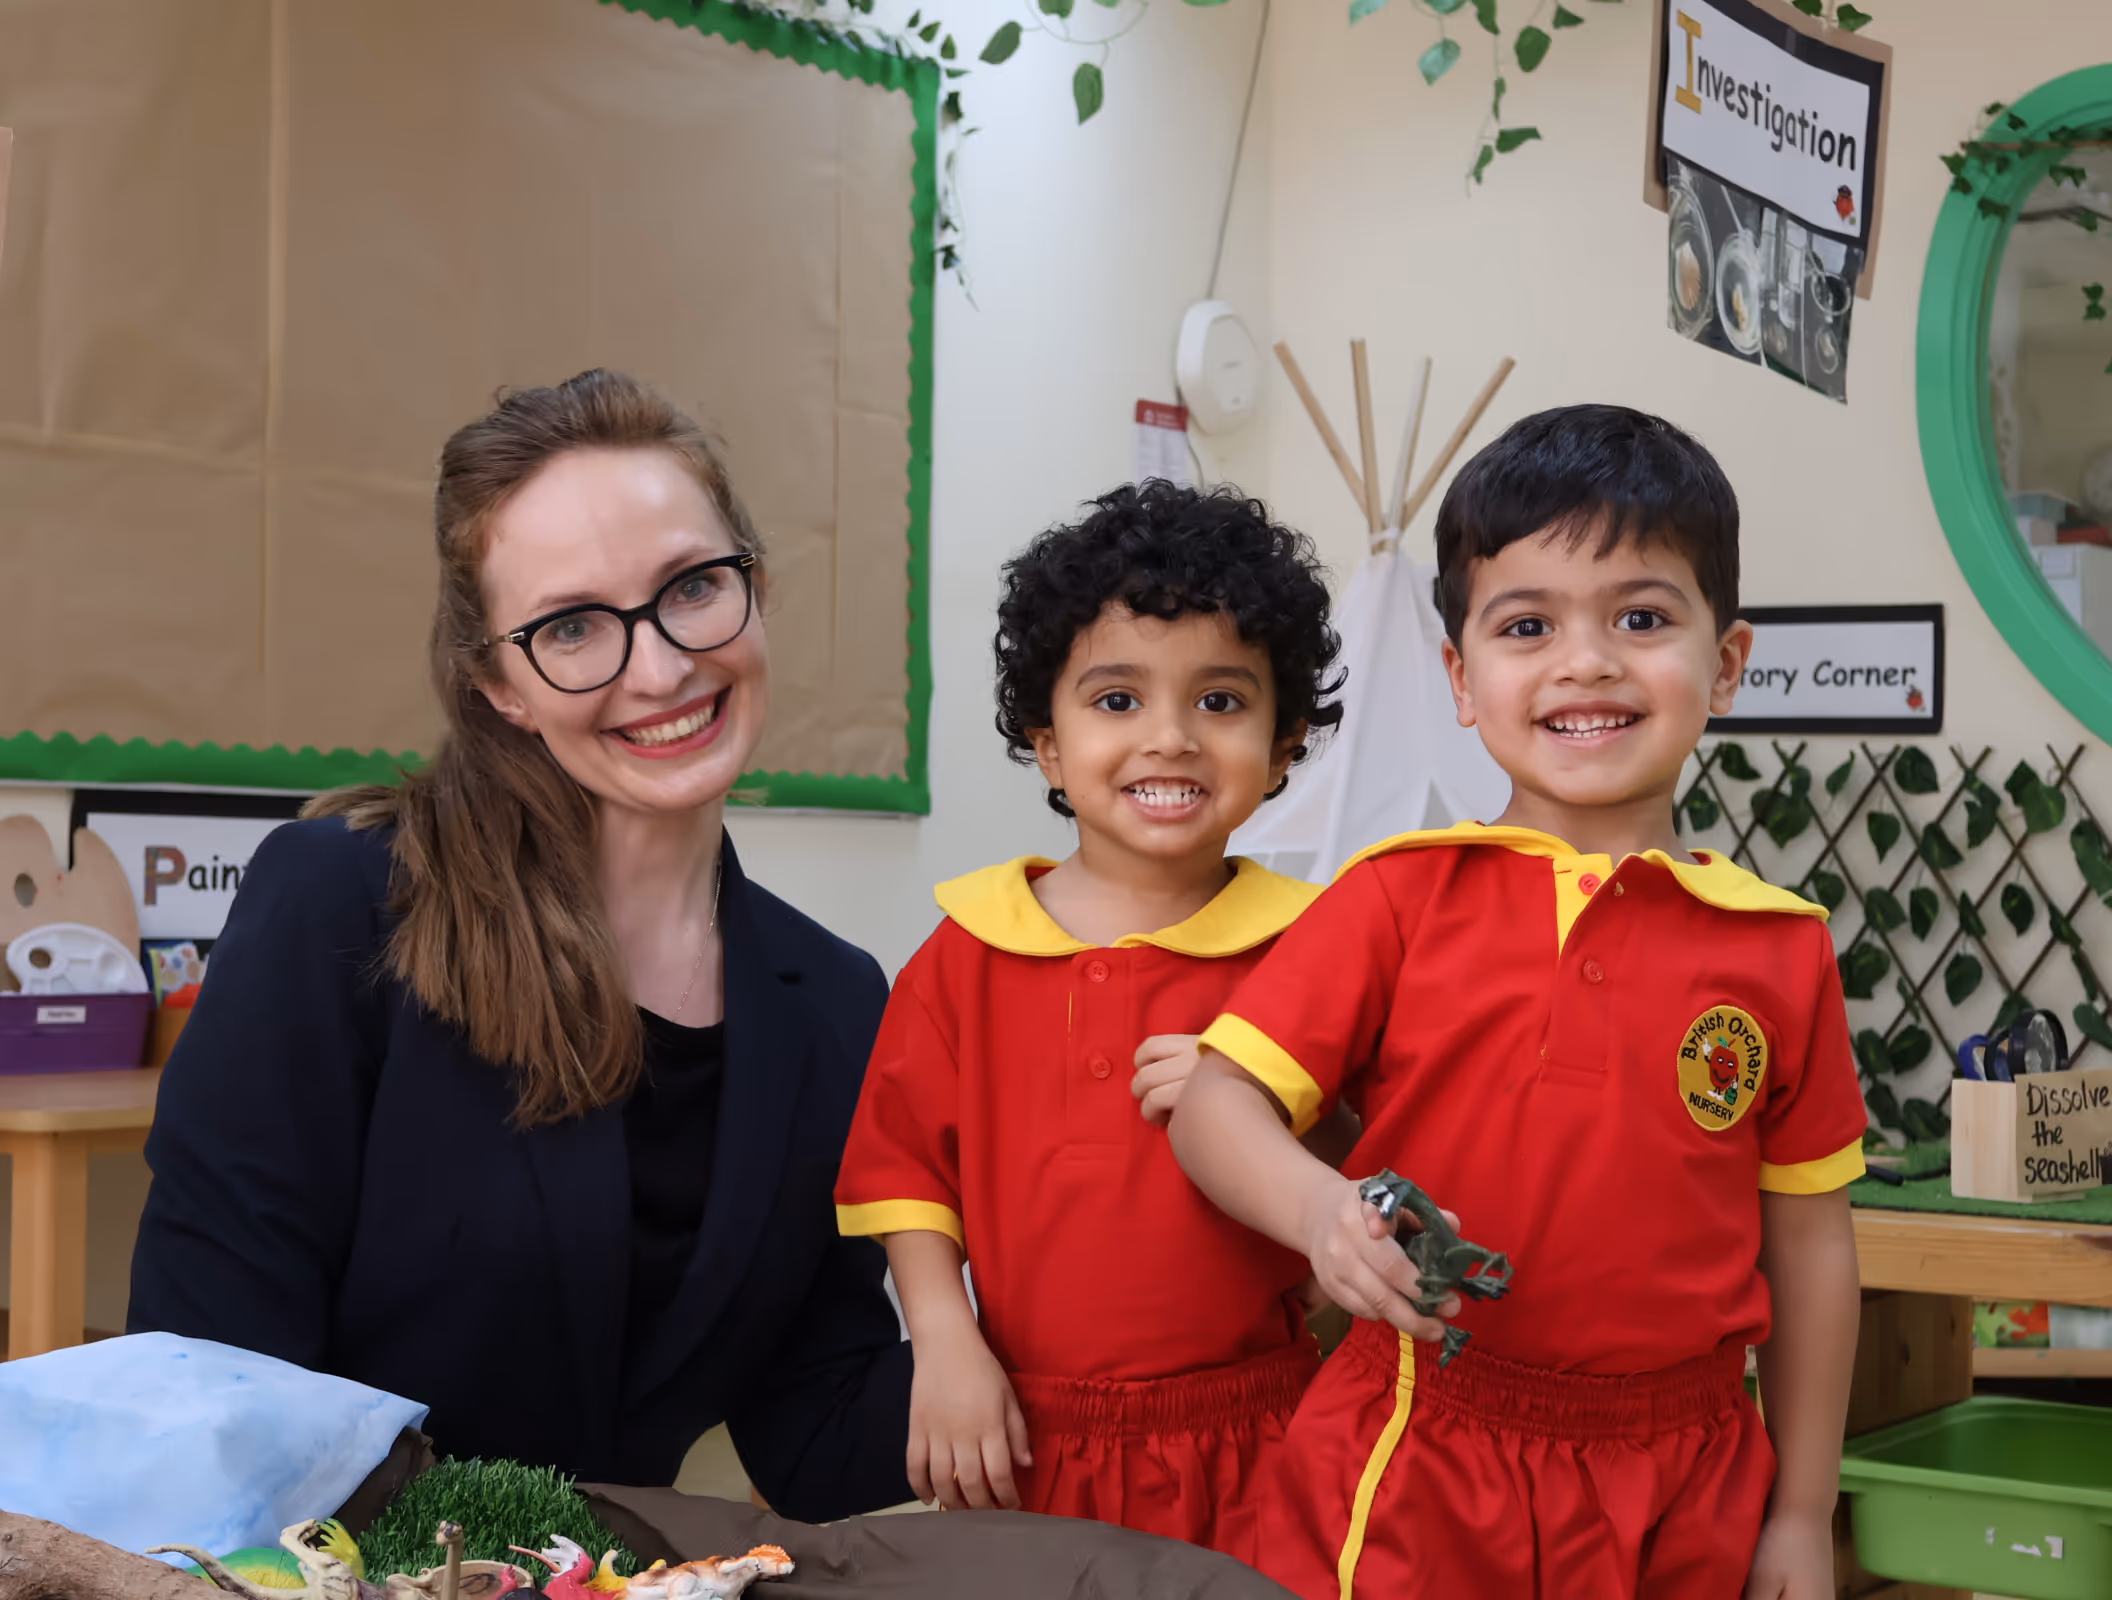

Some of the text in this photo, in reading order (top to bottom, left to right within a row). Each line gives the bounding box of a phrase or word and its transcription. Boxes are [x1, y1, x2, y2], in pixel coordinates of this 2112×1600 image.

[1676, 9, 1856, 171] Investigation
[1812, 660, 1916, 687] Corner
[144, 845, 248, 906] Pain
[1681, 1011, 1763, 1092] British Orchard
[1688, 1091, 1735, 1121] NURSERY
[2026, 1078, 2111, 1118] Dissolve
[2032, 1120, 2064, 1147] the
